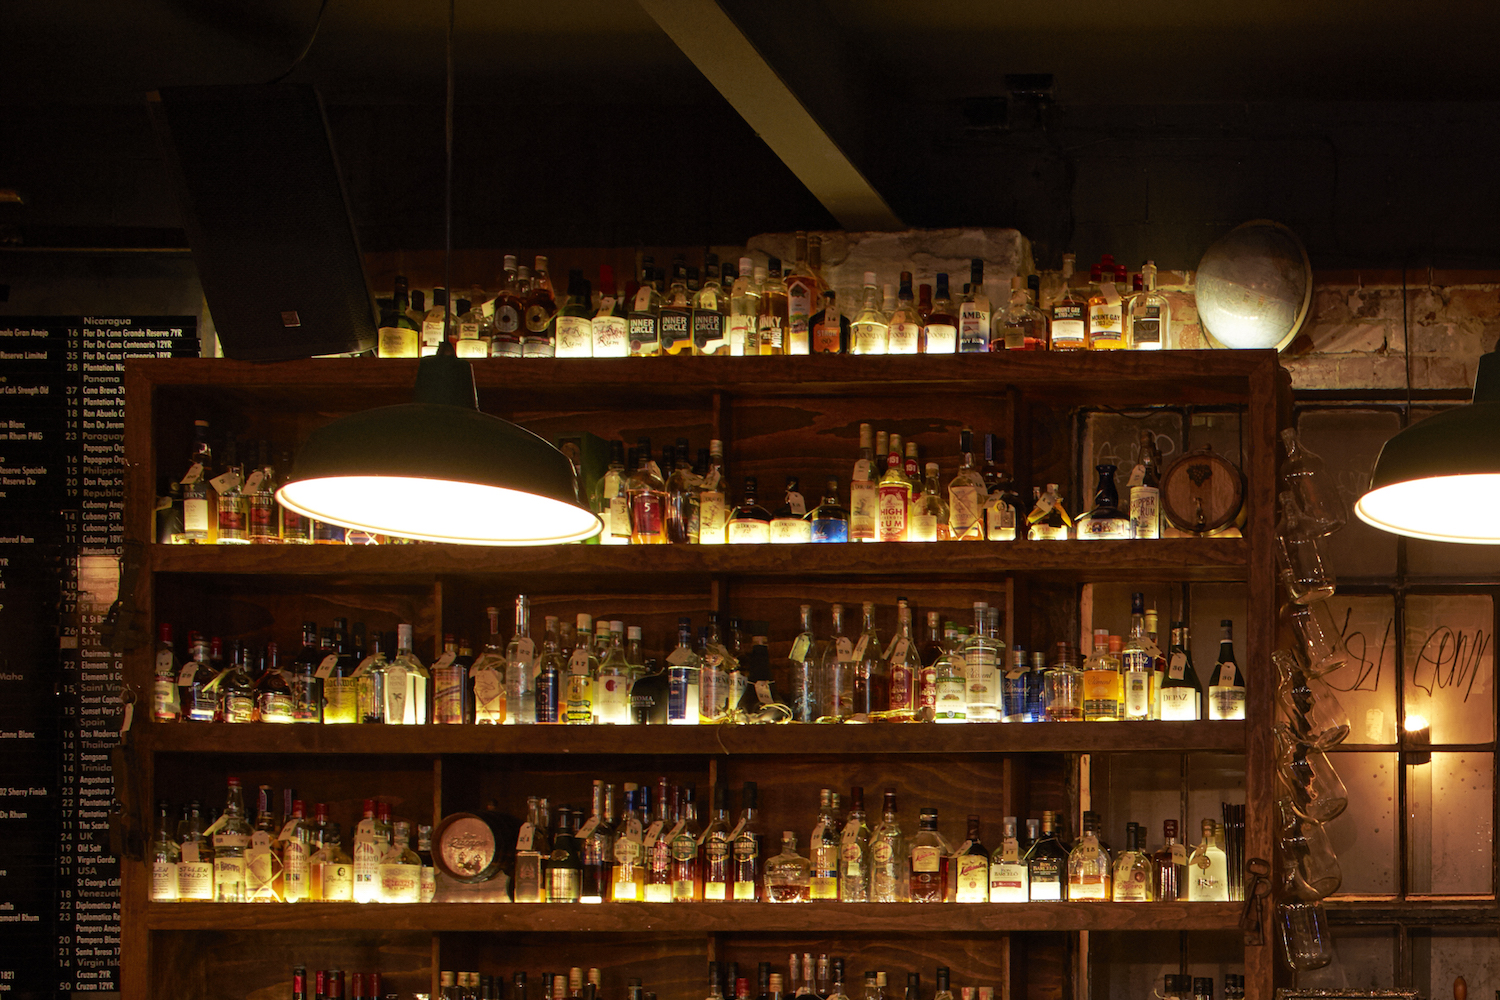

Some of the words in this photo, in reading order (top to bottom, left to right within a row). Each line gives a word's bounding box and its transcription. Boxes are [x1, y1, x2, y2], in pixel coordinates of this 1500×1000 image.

[83, 317, 132, 327] Nicaragua
[630, 319, 654, 327] INNER
[662, 316, 687, 324] INNER
[630, 326, 654, 334] CIRCLE
[695, 323, 719, 331] CIRCLE
[67, 329, 78, 337] 16
[83, 328, 95, 338] Flor
[96, 328, 105, 338] De
[123, 328, 145, 338] Grande
[170, 328, 183, 338] 7YR
[67, 340, 78, 348] 15
[83, 340, 95, 348] Flor
[96, 340, 105, 348] De
[123, 340, 155, 348] Centenario
[157, 340, 172, 348] 12YR
[24, 351, 48, 360] Limited
[66, 352, 78, 360] 35
[66, 364, 78, 372] 28
[83, 363, 114, 372] Plantation
[83, 374, 120, 383] Panama
[40, 386, 49, 395] Old
[66, 387, 77, 395] 37
[67, 410, 78, 418] 18
[65, 432, 77, 440] 23
[888, 456, 899, 464] 151
[906, 464, 916, 472] 151
[644, 503, 651, 512] 5
[880, 508, 902, 516] HIGH
[1140, 508, 1155, 517] RUM
[109, 512, 121, 521] 5YR
[65, 581, 76, 589] 10
[64, 627, 76, 635] 26
[64, 661, 75, 669] 22
[80, 683, 103, 692] Saint
[80, 718, 105, 727] Spain
[63, 730, 75, 738] 16
[62, 787, 73, 796] 23
[60, 833, 73, 841] 24
[79, 832, 94, 840] UK
[77, 844, 89, 853] Old
[77, 867, 97, 875] USA
[59, 913, 71, 921] 23
[77, 959, 104, 968] Virgin
[0, 971, 15, 979] 1821
[98, 970, 111, 979] 2YR
[59, 982, 71, 991] 50
[98, 982, 115, 991] 12YR
